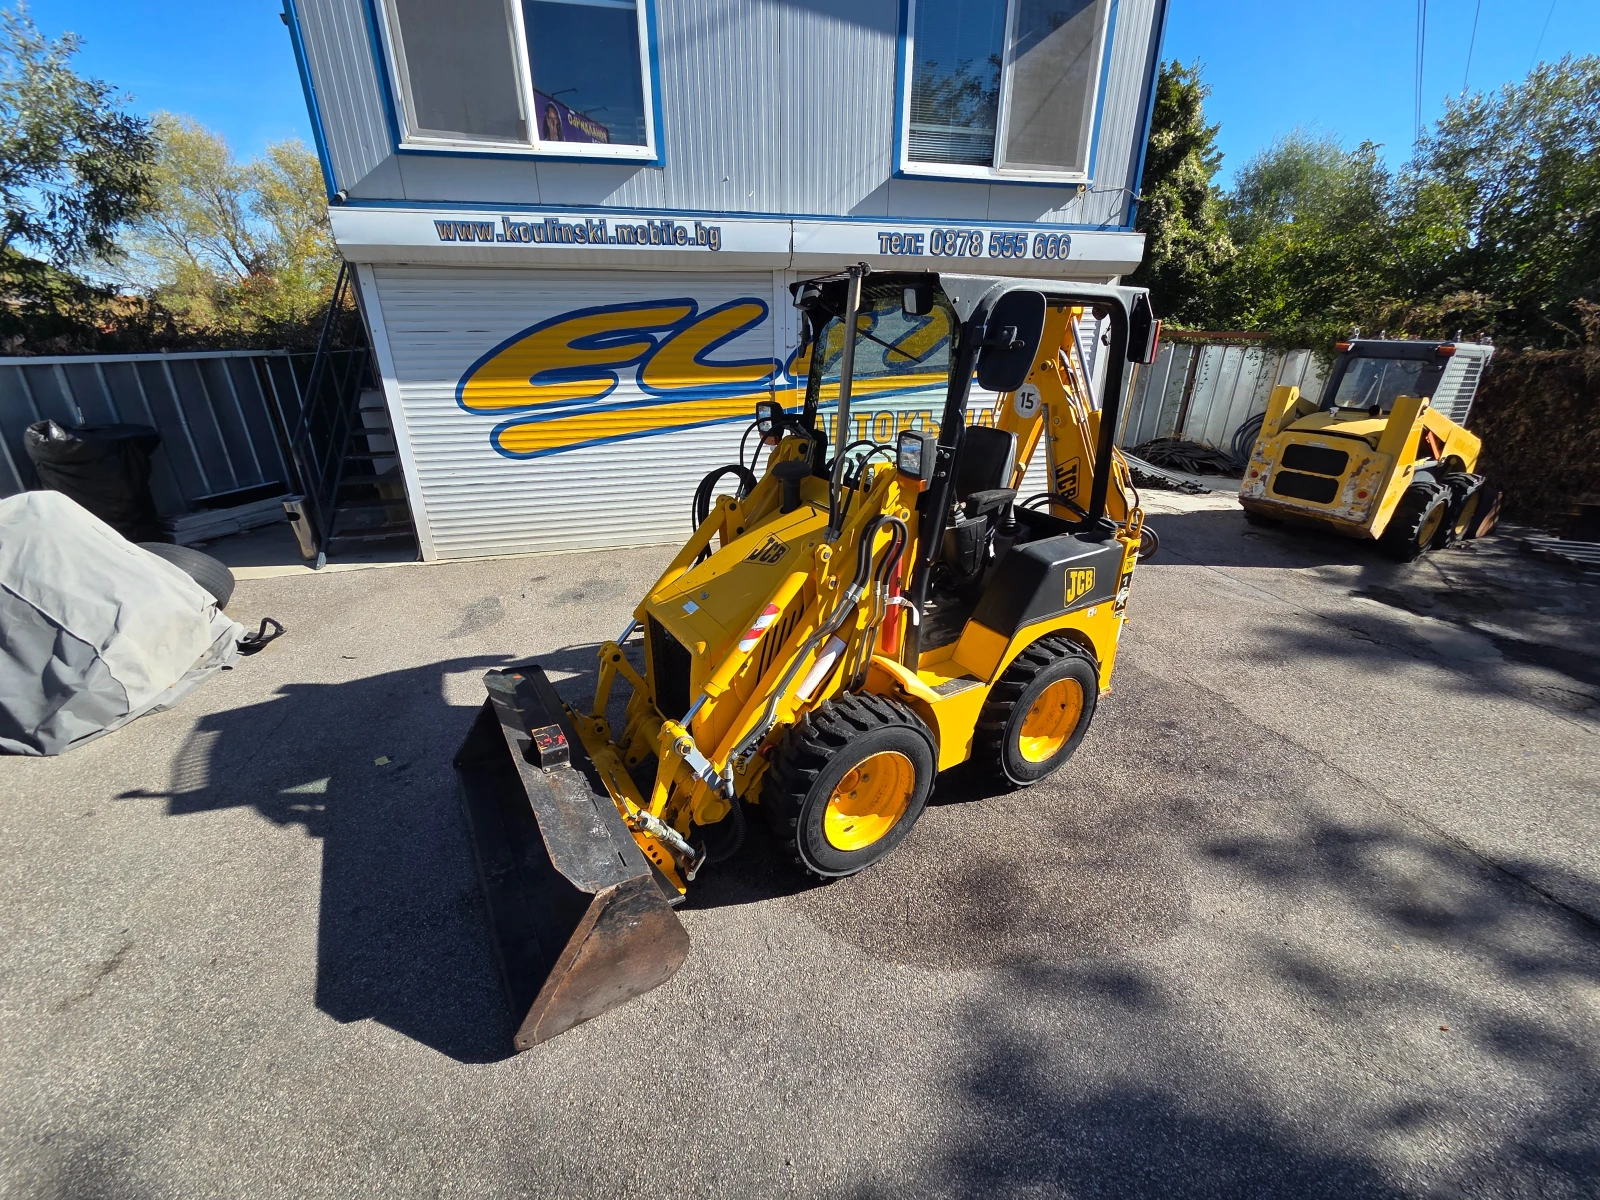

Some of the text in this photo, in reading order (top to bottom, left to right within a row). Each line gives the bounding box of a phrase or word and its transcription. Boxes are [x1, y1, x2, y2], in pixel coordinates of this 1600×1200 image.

[433, 217, 721, 251] www.koulinski.mobile.bg
[878, 228, 1071, 260] тел: 0878 555 666
[1020, 391, 1035, 409] 15
[1055, 463, 1078, 501] JCB
[746, 536, 787, 563] JCB
[1066, 570, 1093, 603] JCB
